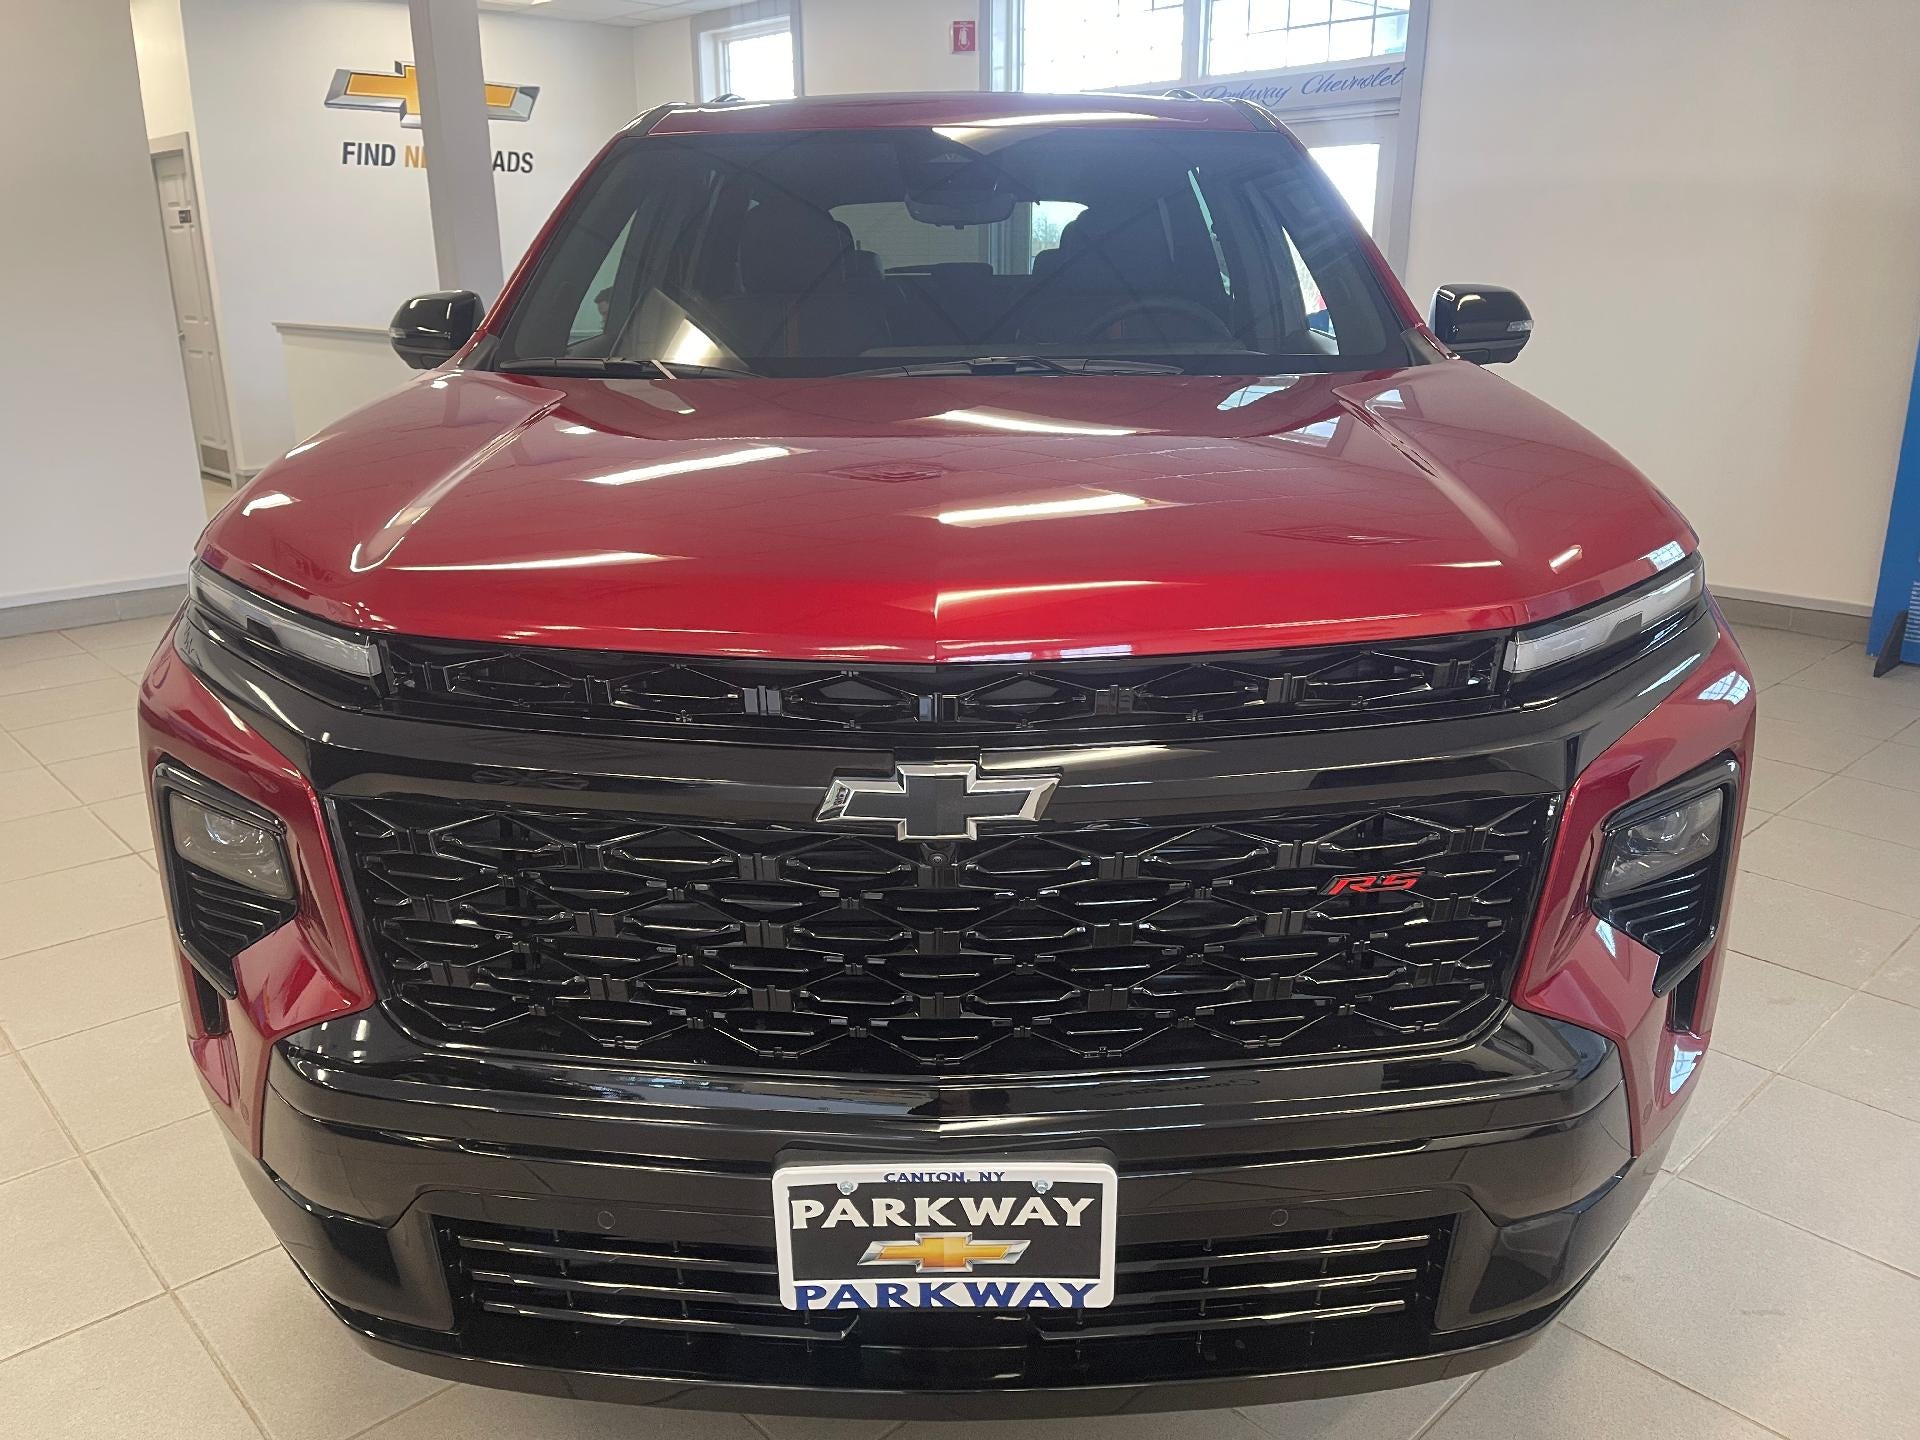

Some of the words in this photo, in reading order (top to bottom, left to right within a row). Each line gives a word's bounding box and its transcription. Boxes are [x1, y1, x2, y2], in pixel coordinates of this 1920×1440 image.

[1300, 67, 1407, 95] Chevrolet
[342, 142, 396, 167] FIND
[492, 150, 533, 173] ADS
[1321, 867, 1425, 896] RS
[883, 1171, 972, 1183] CANTON,
[978, 1171, 1006, 1183] NY
[790, 1197, 1095, 1230] PARKWAY
[794, 1282, 1099, 1311] PARKWAY
